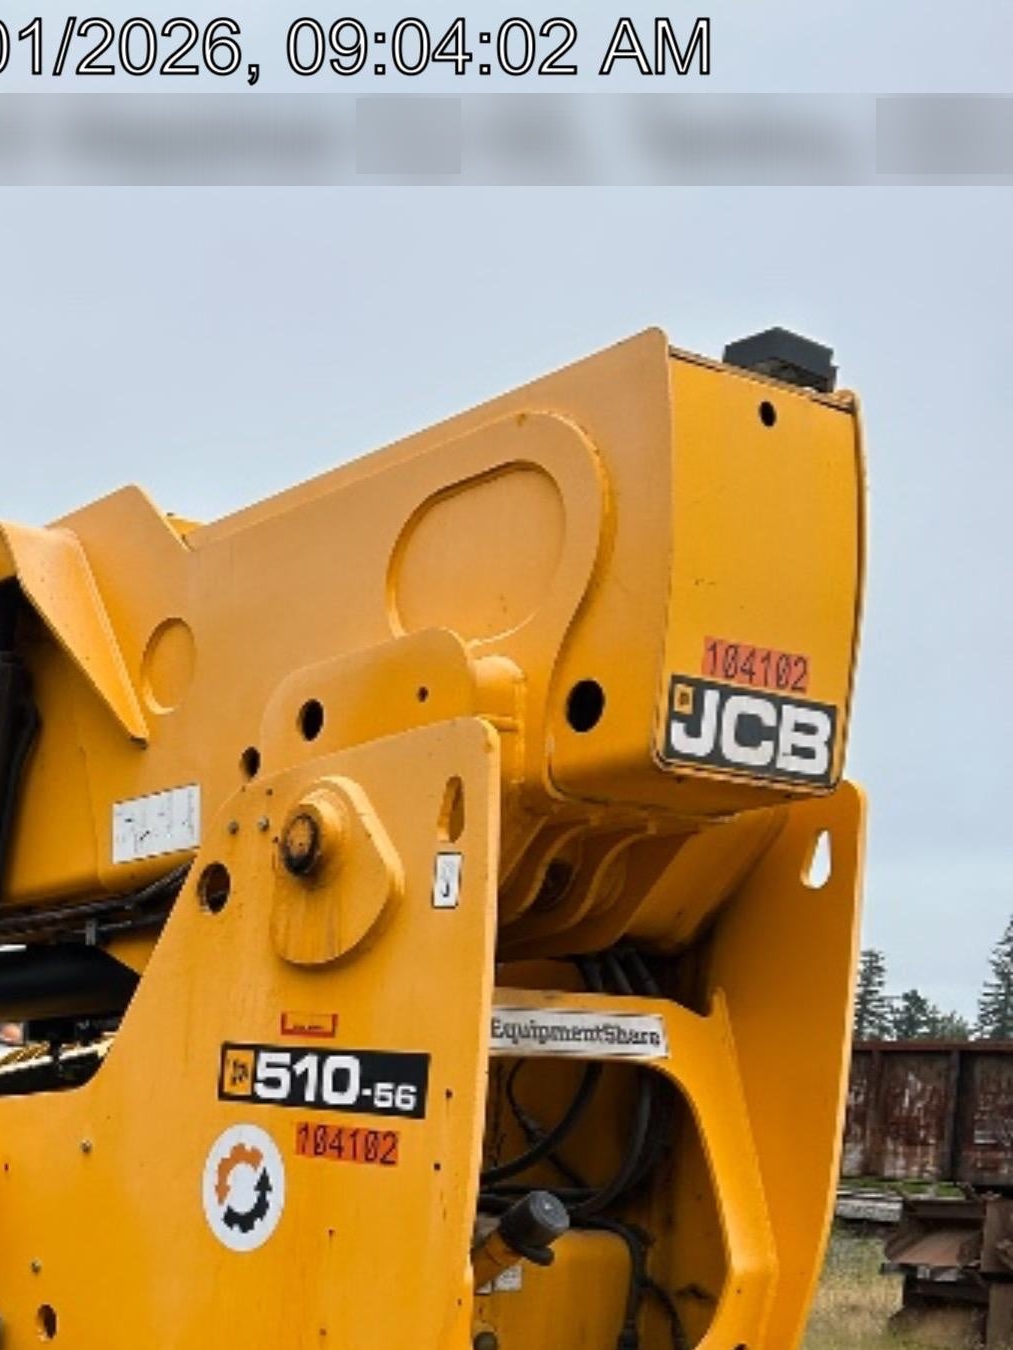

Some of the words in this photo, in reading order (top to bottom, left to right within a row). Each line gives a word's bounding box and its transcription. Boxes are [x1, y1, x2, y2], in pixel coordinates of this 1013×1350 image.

[706, 641, 809, 693] 104102
[671, 689, 831, 775] JCB
[253, 1051, 418, 1112] 510-56
[297, 1122, 399, 1166] 104102
